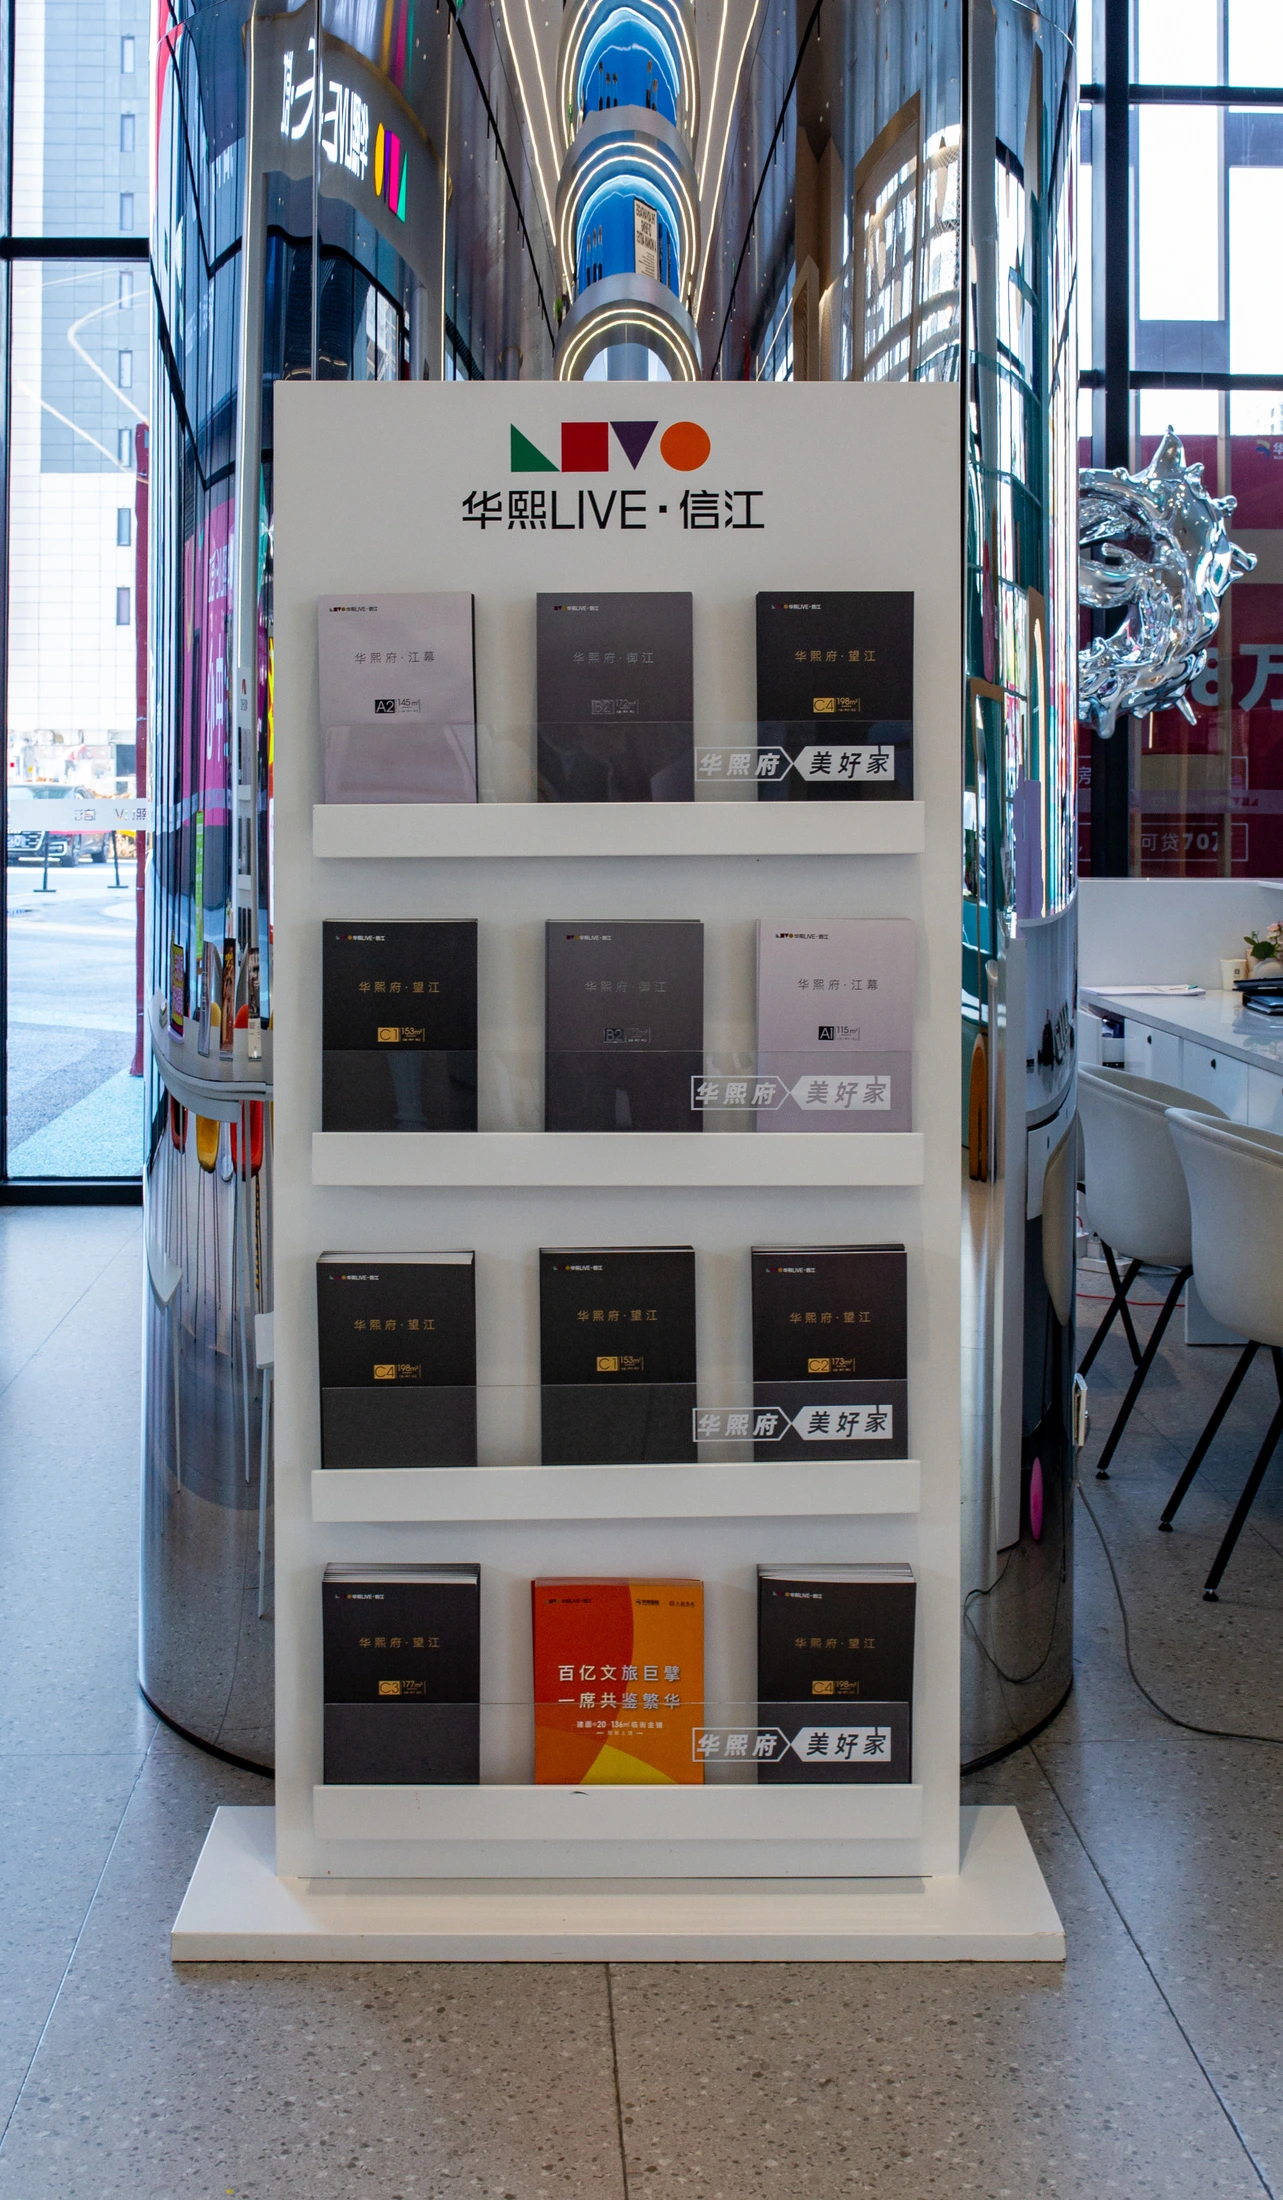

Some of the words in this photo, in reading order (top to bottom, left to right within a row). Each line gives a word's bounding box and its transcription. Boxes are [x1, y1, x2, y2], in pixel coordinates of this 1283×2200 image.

[462, 489, 765, 529] 华熙LIVE·信江
[377, 701, 395, 712] A2
[814, 700, 833, 711] C4
[699, 753, 780, 776] 华熙府
[809, 751, 889, 778] 美好家
[380, 1029, 398, 1041] C1
[606, 1029, 624, 1041] B2
[820, 1028, 833, 1039] A1
[695, 1082, 776, 1105] 华熙府
[806, 1080, 887, 1108] 美好家
[599, 1359, 617, 1370] C1
[809, 1360, 829, 1371] C2
[375, 1366, 394, 1378] C4
[698, 1413, 778, 1437] 华熙府
[808, 1411, 888, 1437] 美好家
[558, 1665, 680, 1682] 百亿文旅巨擘
[380, 1683, 399, 1694] C3
[813, 1683, 833, 1694] C4
[558, 1692, 680, 1710] 一席共鉴繁华
[697, 1733, 777, 1757] 华熙府
[806, 1733, 886, 1759] 美好家
